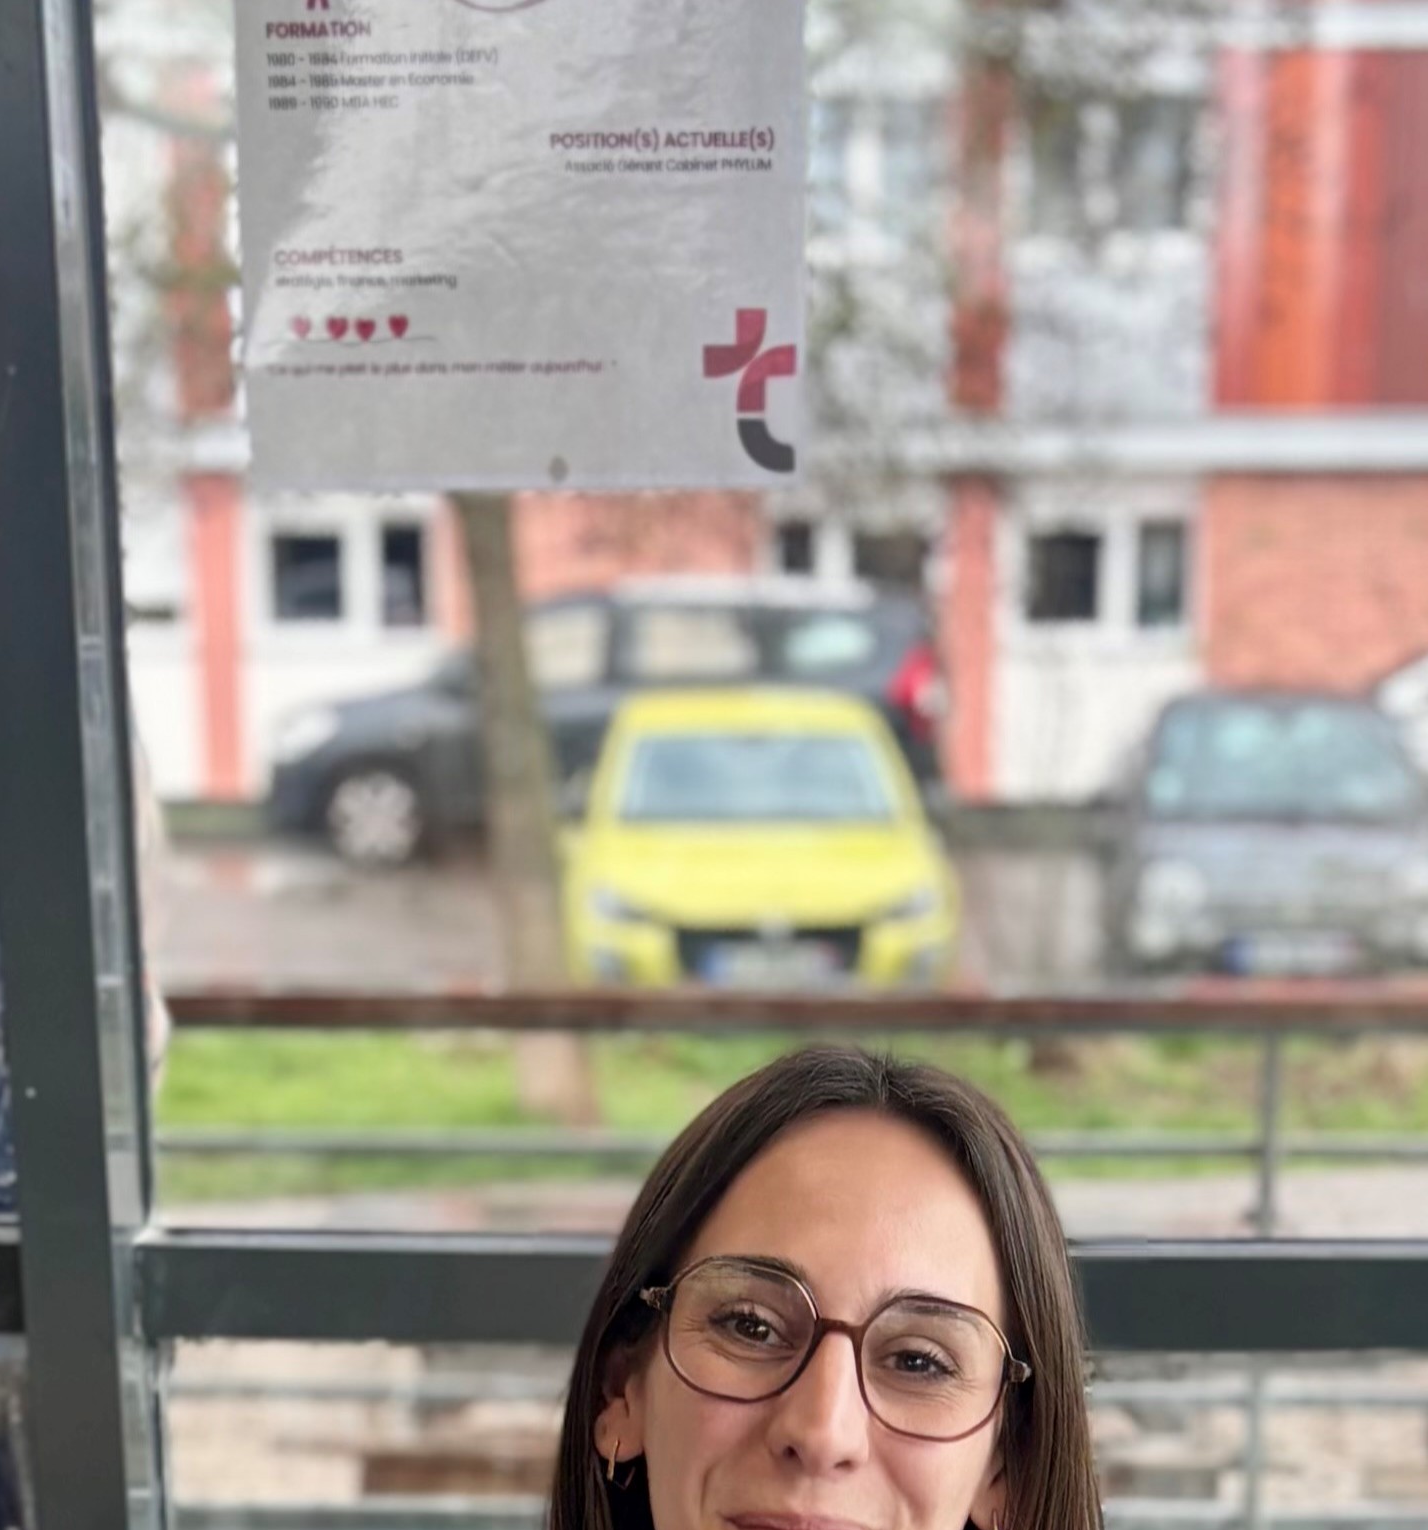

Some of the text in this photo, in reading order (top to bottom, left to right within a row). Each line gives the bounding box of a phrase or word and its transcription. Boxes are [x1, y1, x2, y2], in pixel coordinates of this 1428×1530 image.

[266, 21, 372, 39] FORMATION
[550, 125, 775, 152] POSITION(S) ACTUELLE(S)
[666, 157, 718, 172] Cabinet
[274, 245, 404, 266] COMPÉTENCES
